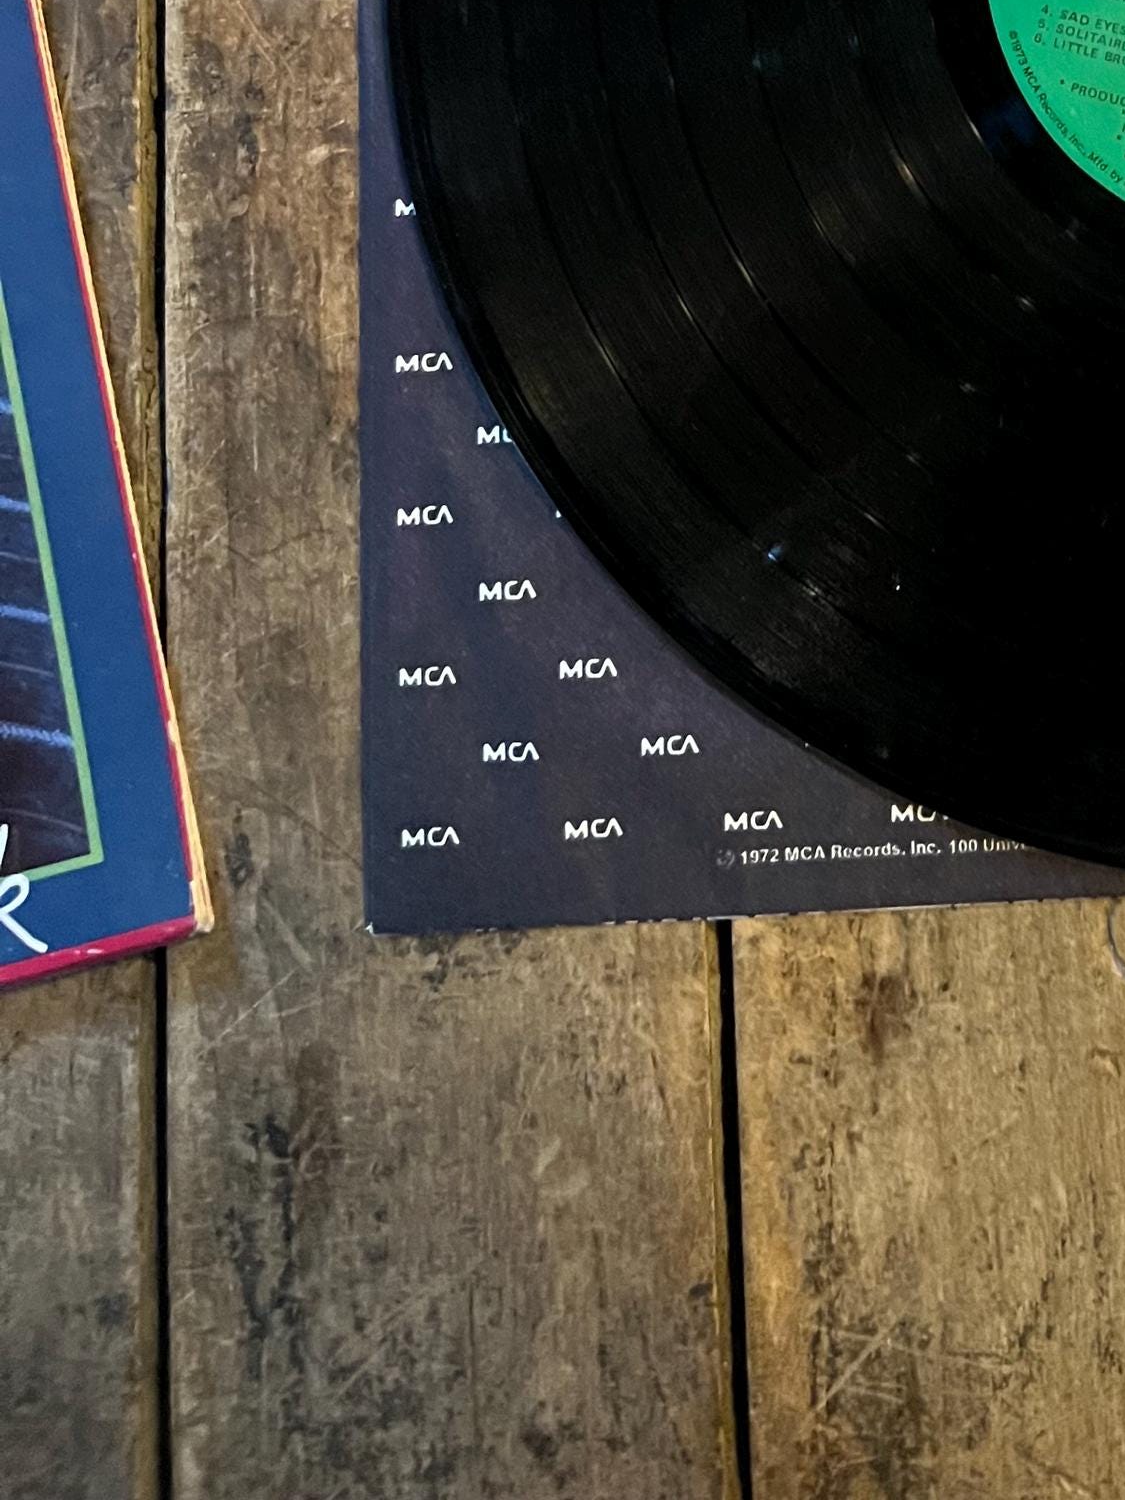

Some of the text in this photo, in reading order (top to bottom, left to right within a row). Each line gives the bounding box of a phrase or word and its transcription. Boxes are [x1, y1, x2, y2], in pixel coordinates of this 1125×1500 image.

[1058, 8, 1090, 26] SAD
[1053, 38, 1098, 58] LITTLE
[1024, 67, 1040, 93] MCA
[1110, 169, 1123, 183] by
[395, 352, 453, 373] MCA
[397, 505, 453, 526] MCA
[479, 580, 536, 601] MCA
[399, 666, 456, 686] MCA
[559, 658, 617, 679] MCA
[483, 742, 539, 762] MCA
[641, 735, 699, 756] MCA
[565, 818, 623, 840] MCA
[724, 811, 783, 831] MCA
[401, 827, 460, 847] MCA
[741, 848, 779, 865] 1972
[785, 846, 825, 862] MCA
[911, 840, 941, 856] Inc.
[949, 839, 978, 855] 100
